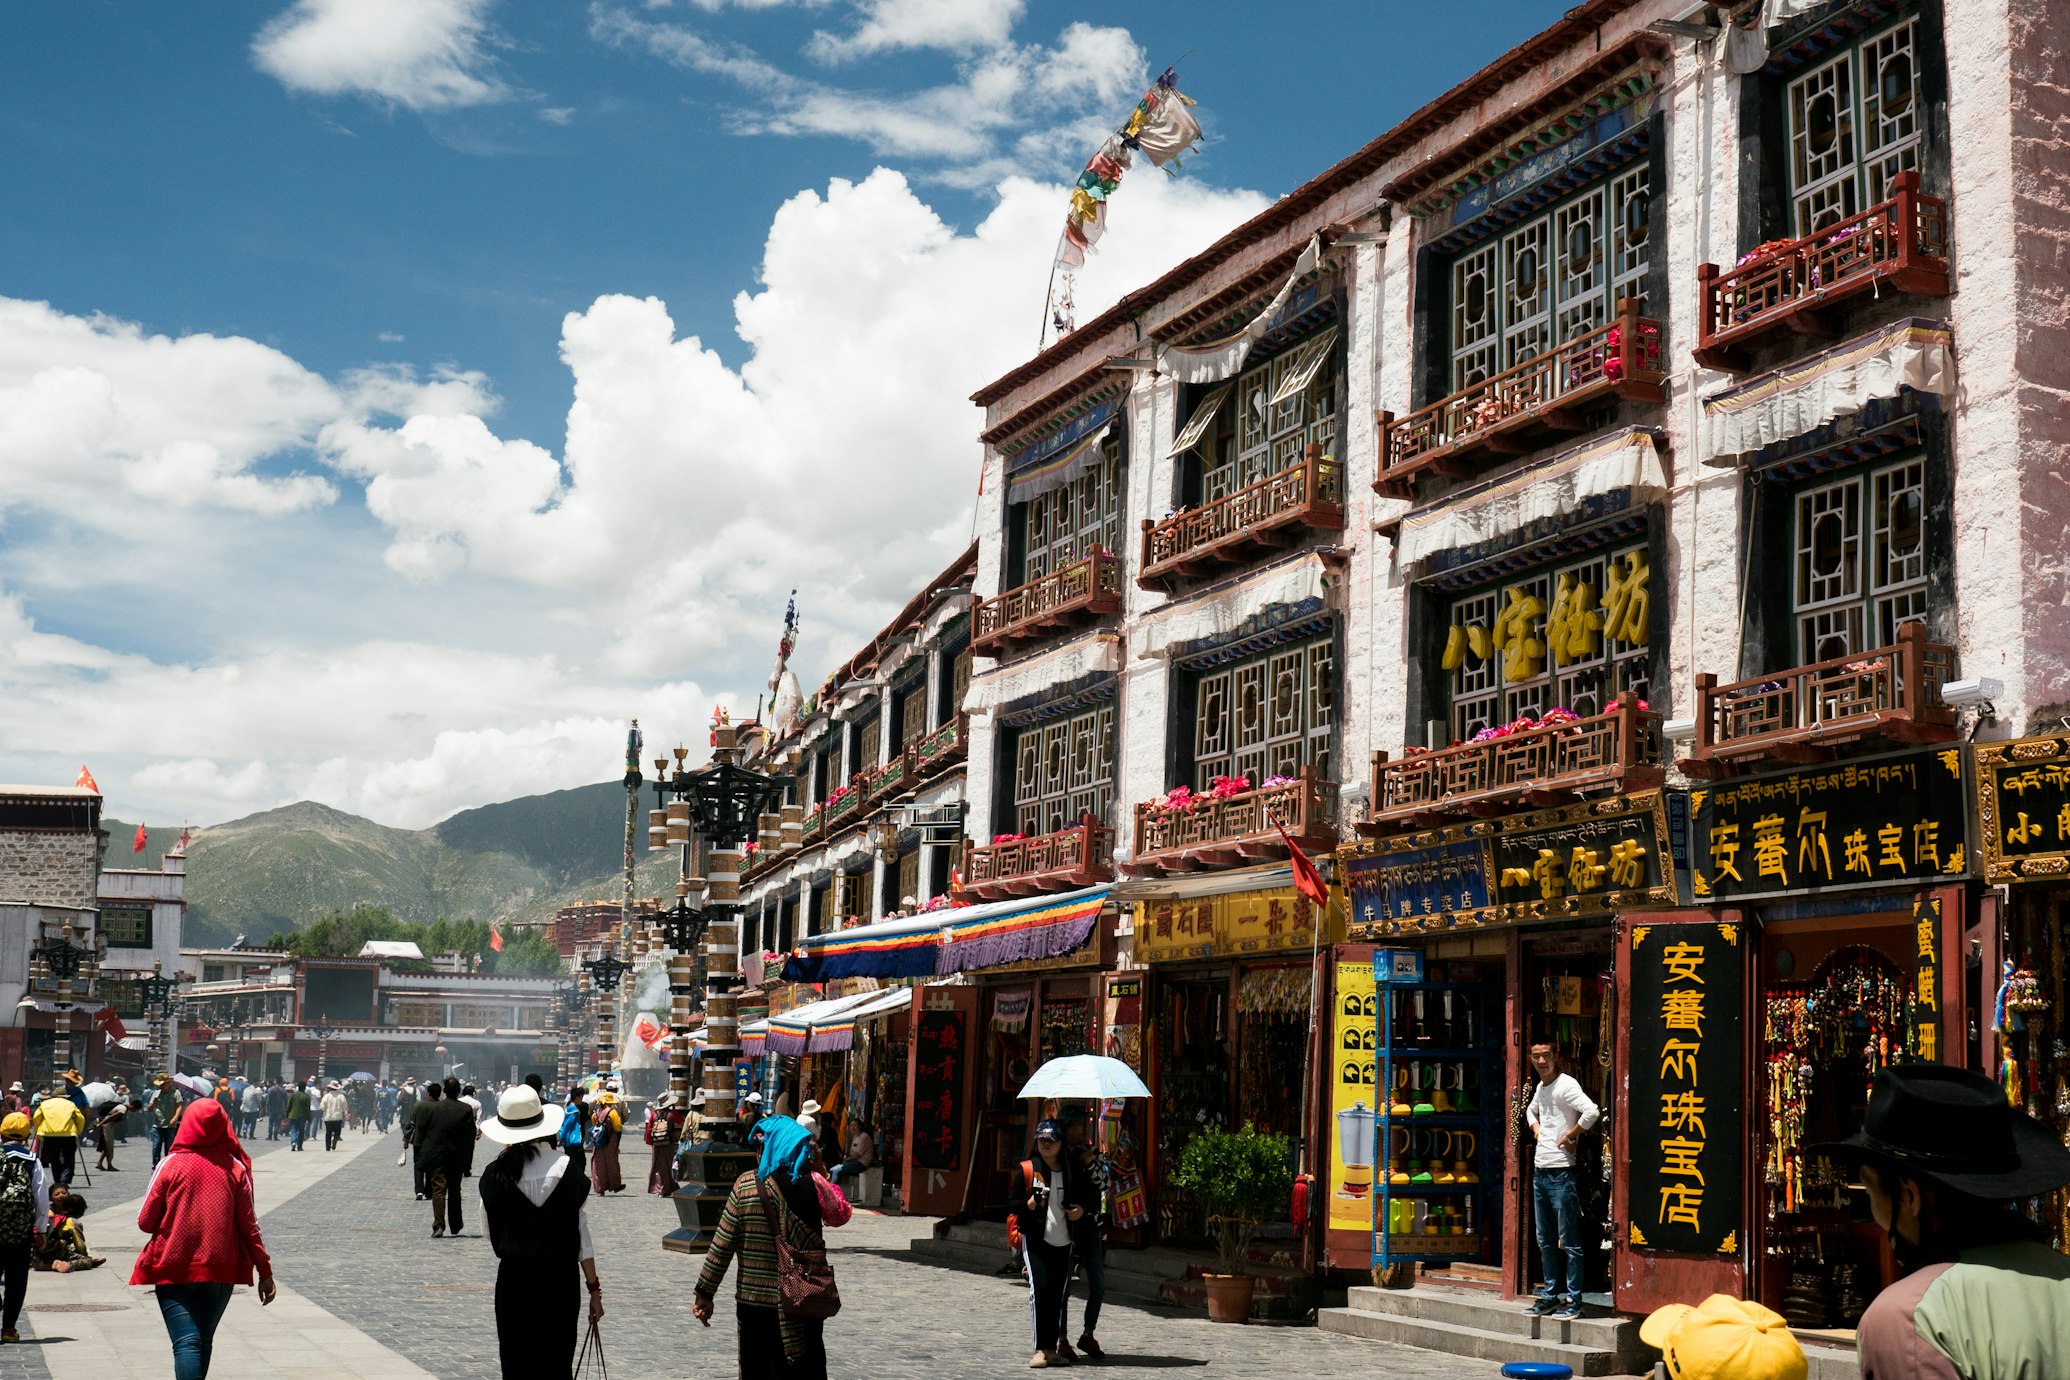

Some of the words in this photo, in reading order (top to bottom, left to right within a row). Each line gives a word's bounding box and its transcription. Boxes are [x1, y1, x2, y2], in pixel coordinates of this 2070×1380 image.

[1364, 890, 1472, 921] 牛马牌专卖店
